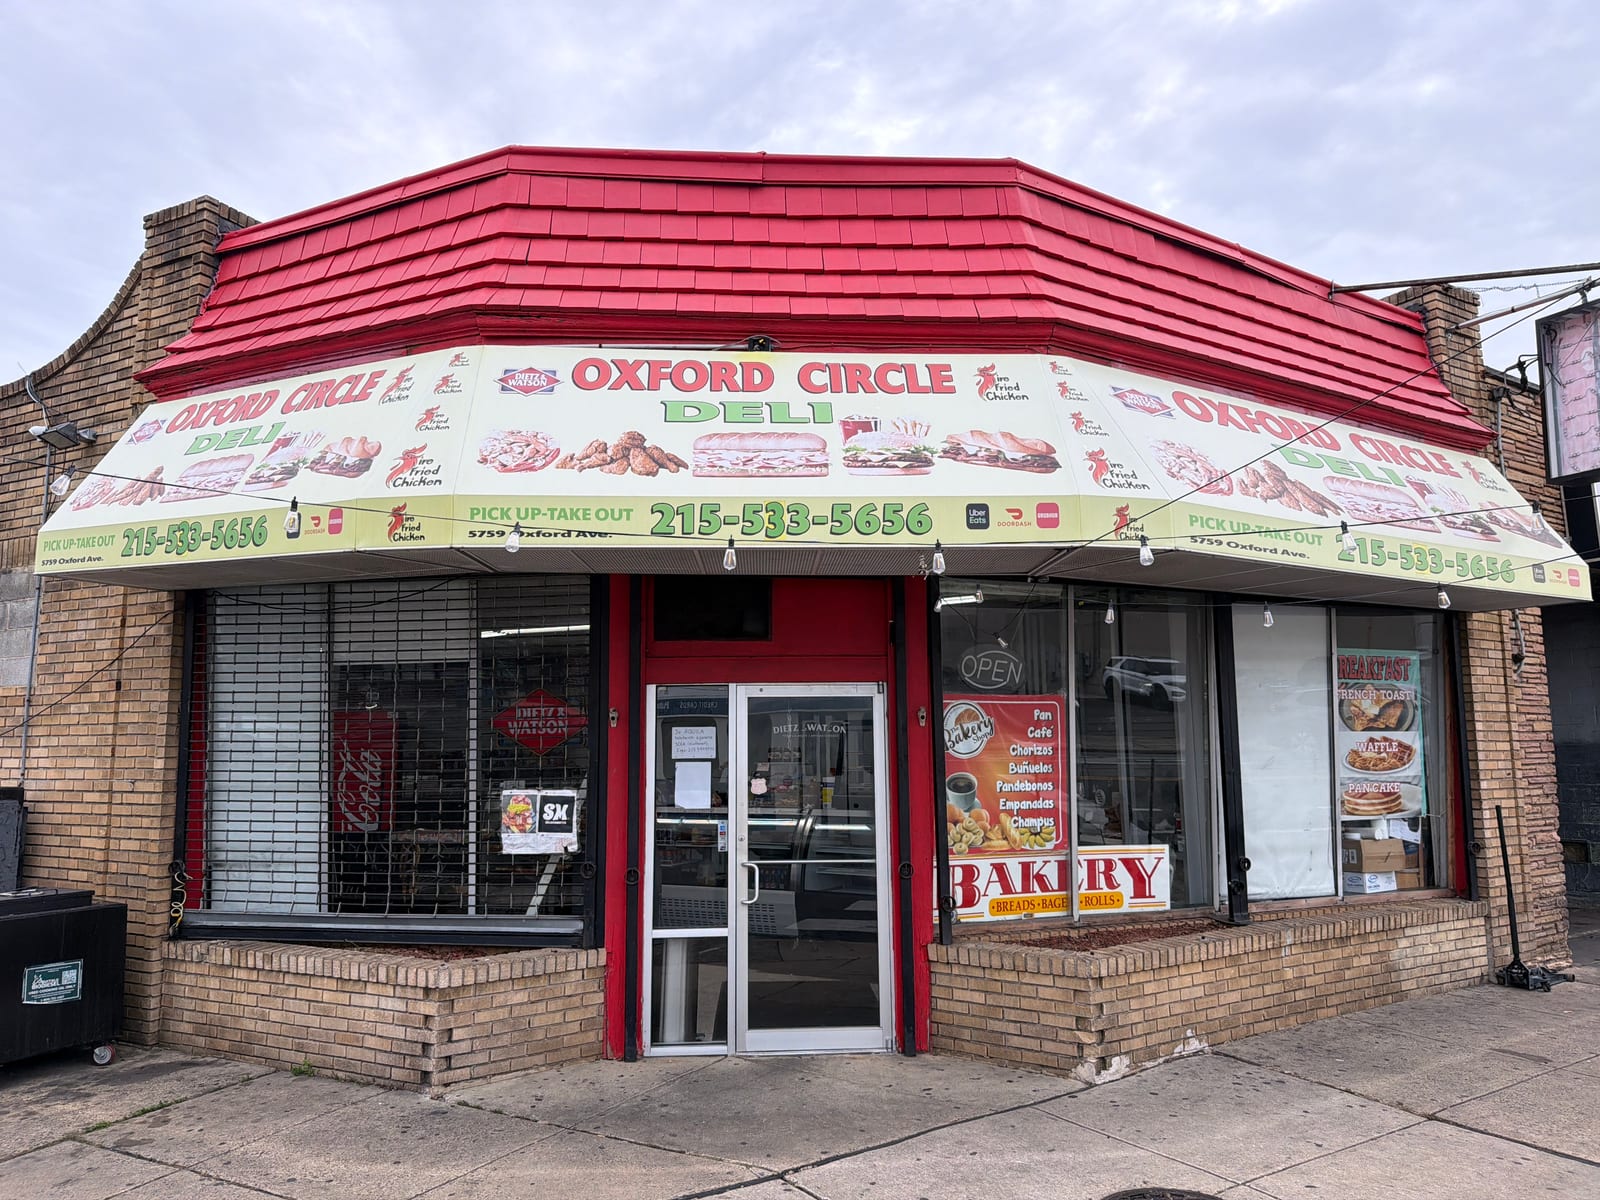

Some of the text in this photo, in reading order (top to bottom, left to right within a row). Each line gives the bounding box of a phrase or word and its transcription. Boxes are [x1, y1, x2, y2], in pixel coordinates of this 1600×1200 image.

[571, 357, 957, 395] OXFORD CIRCLE
[995, 382, 1020, 391] Fried
[165, 370, 387, 434] OXFORD CIRCLE
[986, 392, 1029, 401] Chicken
[660, 400, 833, 424] DELI
[184, 422, 286, 456] DELI
[1171, 391, 1463, 479] OXFORD CIRCLE
[409, 464, 441, 476] Fried
[1271, 443, 1406, 488] DELI
[393, 476, 442, 487] Chicken
[1109, 470, 1138, 480] Fried
[1102, 478, 1150, 490] Chicken
[469, 507, 512, 520] PICK
[594, 508, 634, 521] OUT
[650, 502, 933, 538] 215-533-5656
[969, 516, 986, 524] Eats
[401, 522, 421, 532] Fried
[1126, 523, 1144, 532] Fried
[1188, 514, 1227, 531] PICK
[1294, 531, 1323, 546] OUT
[121, 515, 268, 557] 215-533-5656
[392, 532, 425, 542] Chicken
[468, 530, 505, 538] 5759
[575, 530, 613, 538] Ave.
[1120, 532, 1148, 541] Chick
[43, 540, 62, 552] PICK
[97, 534, 116, 547] OUT
[1190, 536, 1310, 559] 5759 Oxford Ave.
[58, 556, 86, 564] Oxford
[1336, 533, 1515, 584] 215-533-5656
[961, 655, 1023, 684] OPEN
[1338, 655, 1411, 681] REAKFAST
[1033, 709, 1052, 721] Pan
[508, 720, 568, 734] WATSON
[773, 723, 846, 734] DIETZ WATON
[1027, 725, 1054, 738] Café
[972, 732, 989, 743] Shop
[1010, 744, 1053, 756] Chorizos
[1356, 742, 1399, 752] WAFFLE
[1008, 761, 1053, 774] Buñuelos
[996, 780, 1054, 792] Pandebonos
[1348, 783, 1400, 793] PANCAKE
[542, 803, 568, 820] SM
[999, 798, 1054, 815] Empanadas
[1010, 816, 1055, 832] Champus
[934, 856, 1164, 910] BAKERY
[996, 895, 1115, 912] BREADS BAGE ROLLS
